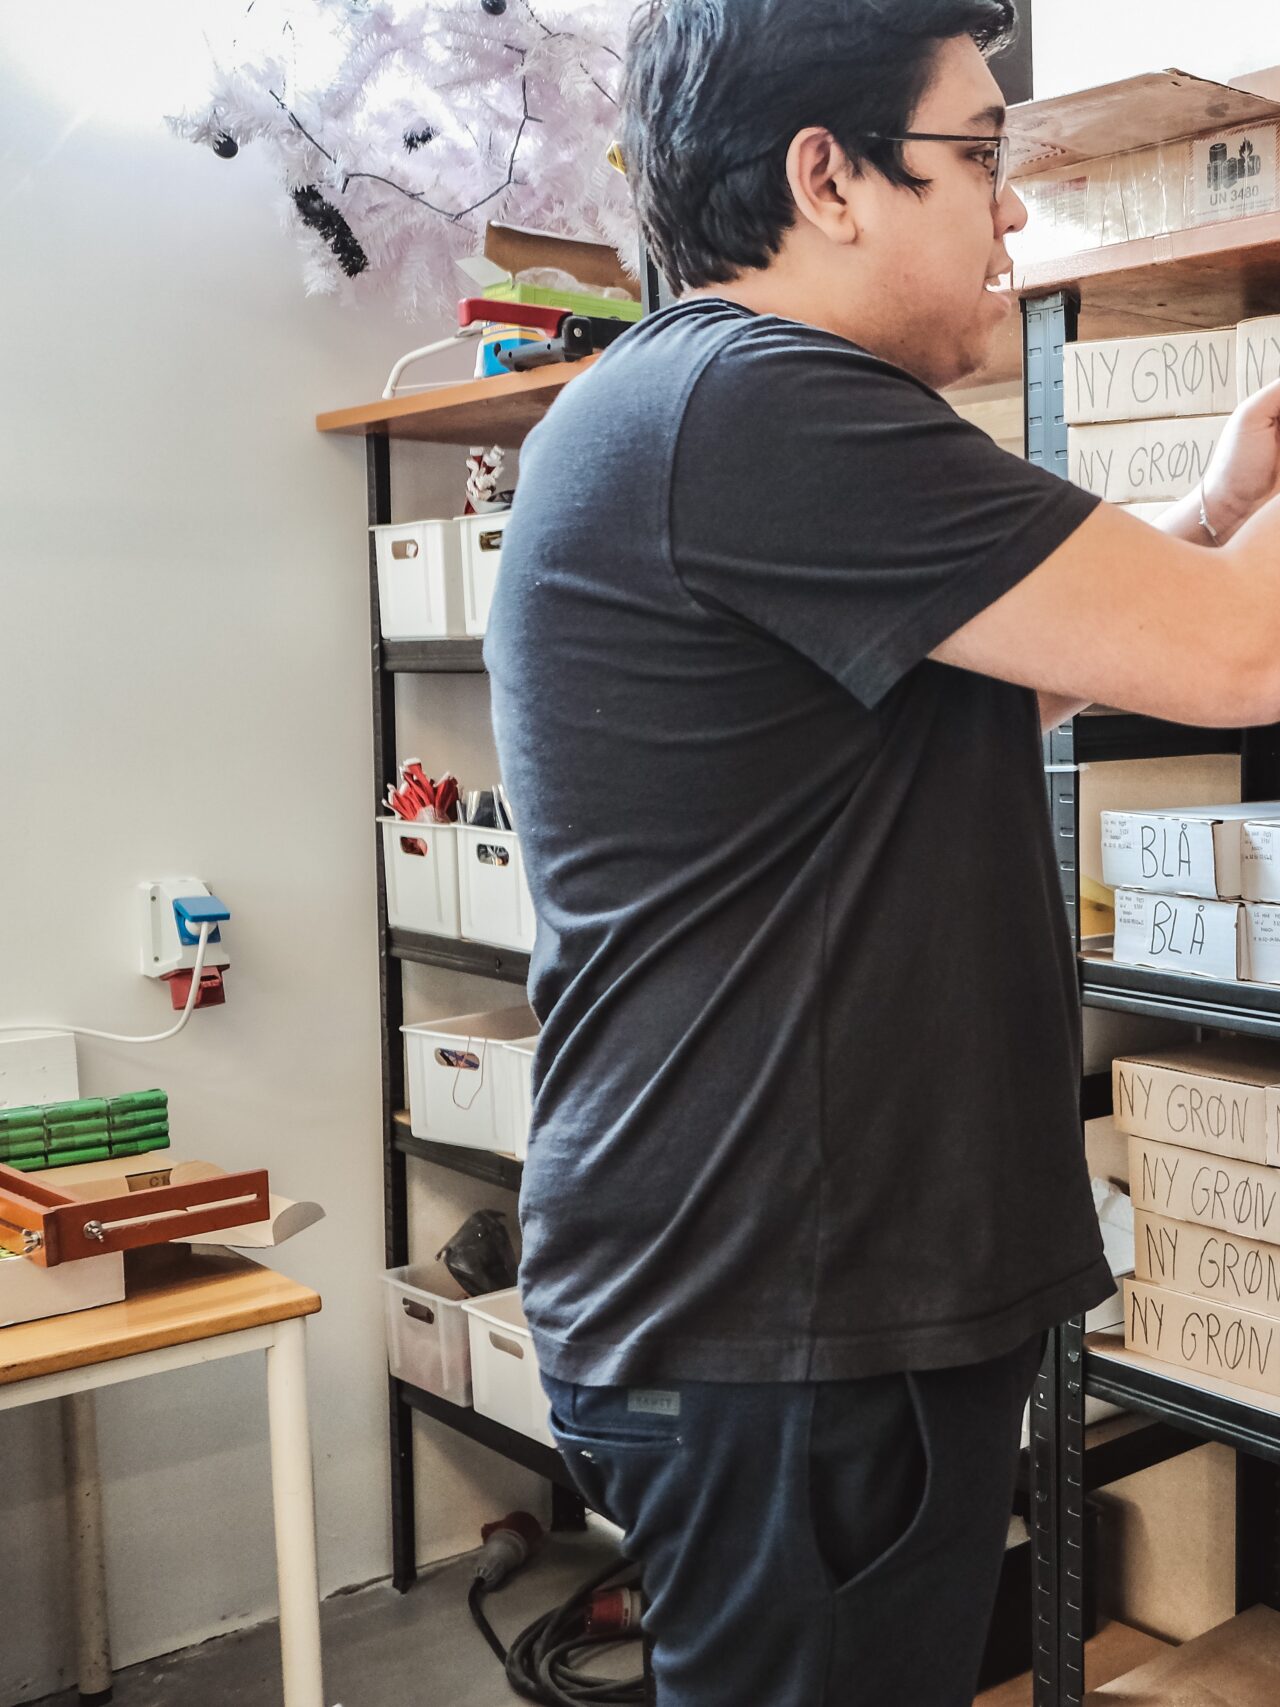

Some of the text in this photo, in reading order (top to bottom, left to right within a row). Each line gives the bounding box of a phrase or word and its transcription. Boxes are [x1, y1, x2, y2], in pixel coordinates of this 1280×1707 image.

[1209, 185, 1259, 206] UN 3480
[1074, 339, 1230, 412] NY GRØN
[1078, 440, 1214, 496] NY GRØN
[1140, 822, 1191, 879] BLÅ
[1148, 900, 1205, 955] BLÅ
[1117, 1069, 1249, 1144] NY GRØN
[1142, 1151, 1277, 1232] NY GRØN
[1145, 1223, 1178, 1281] NY
[1131, 1290, 1273, 1376] NY GRØN
